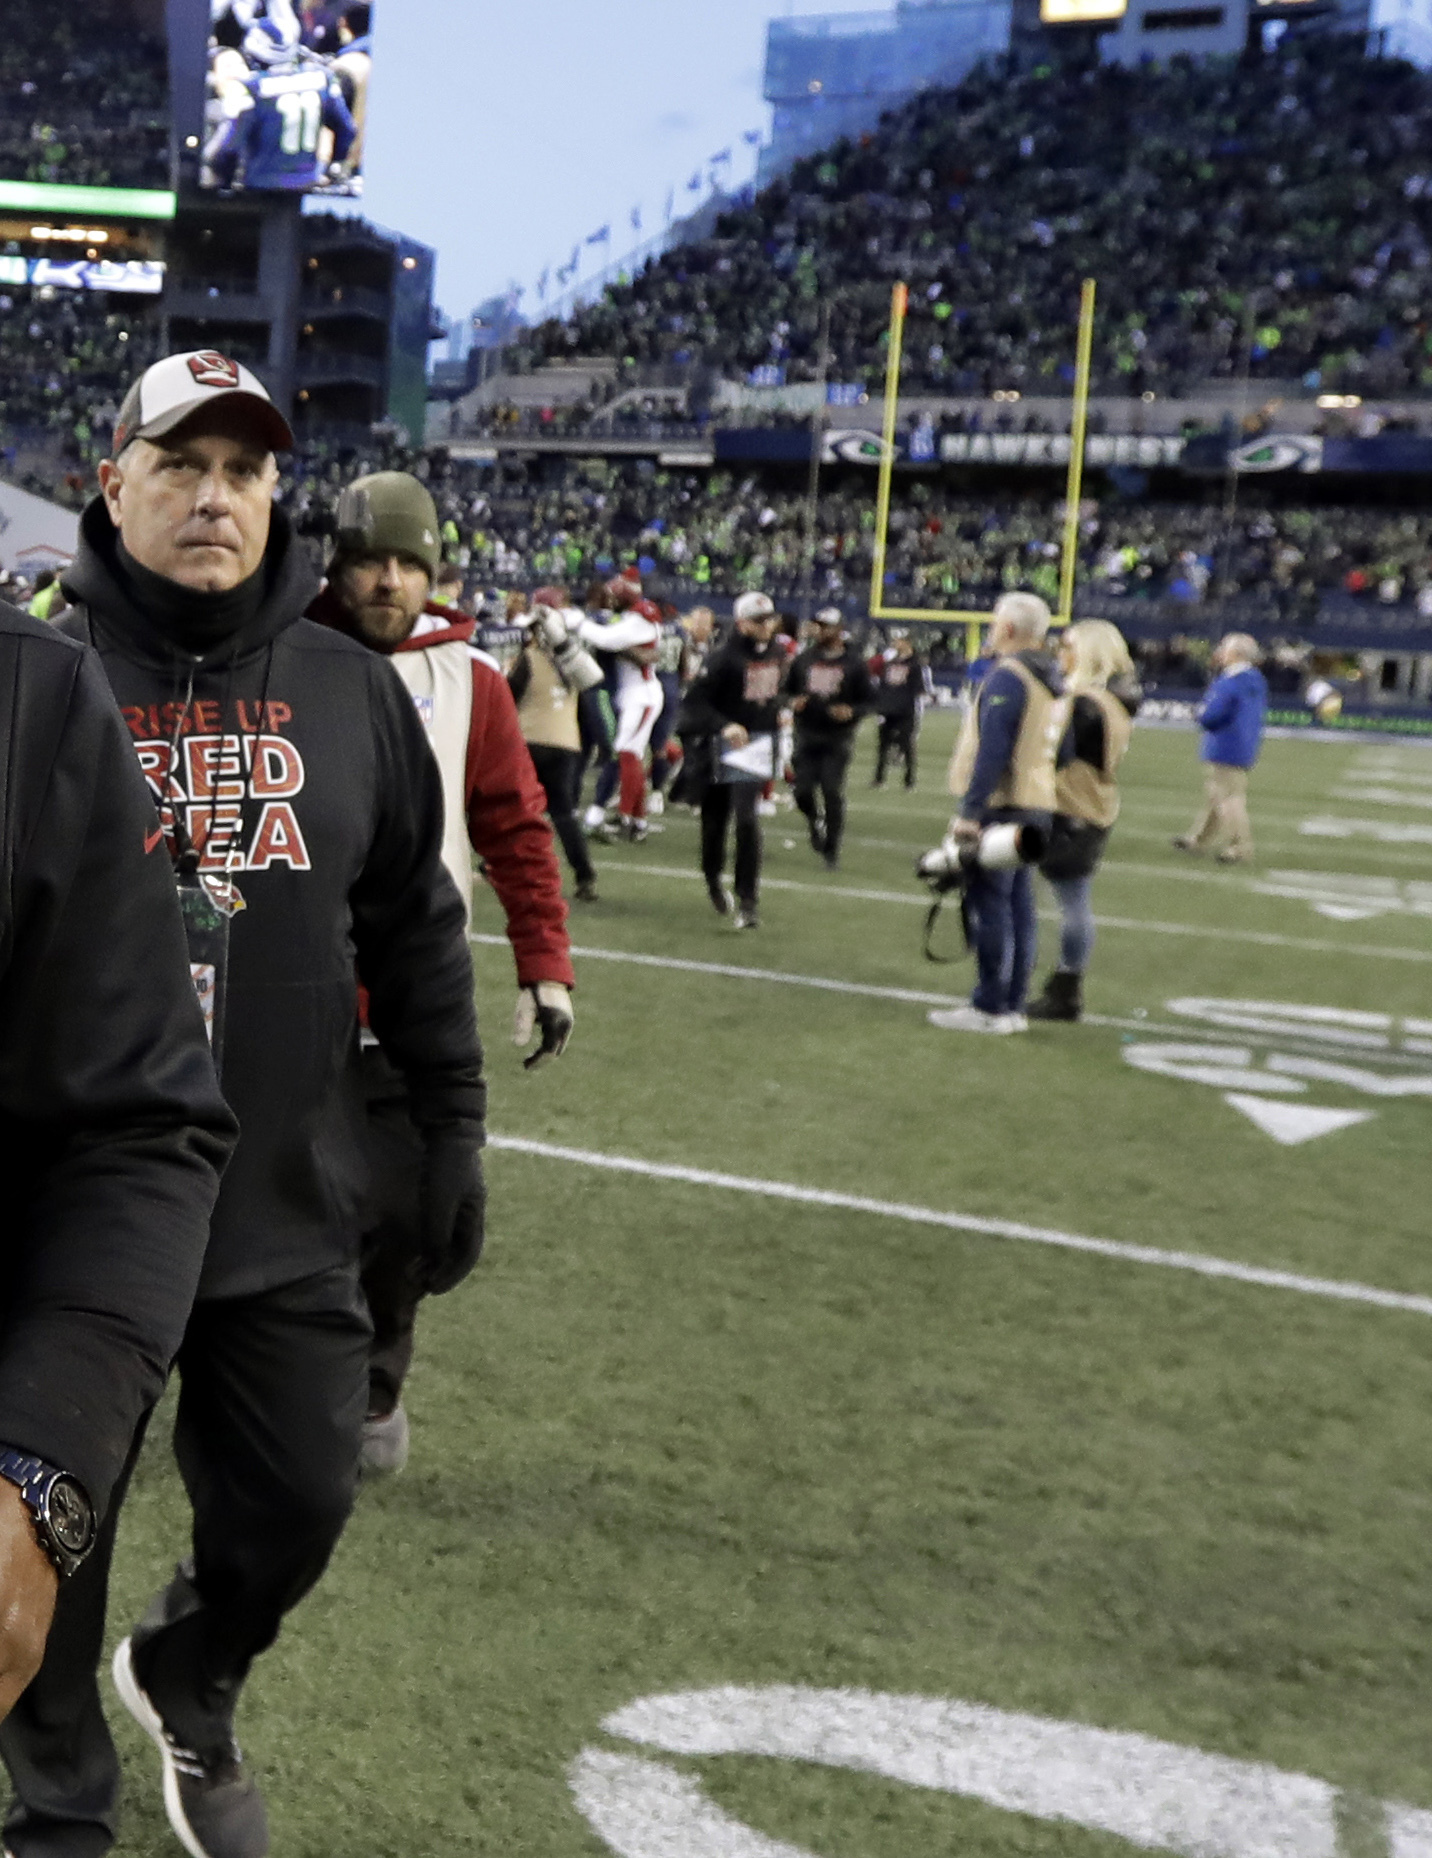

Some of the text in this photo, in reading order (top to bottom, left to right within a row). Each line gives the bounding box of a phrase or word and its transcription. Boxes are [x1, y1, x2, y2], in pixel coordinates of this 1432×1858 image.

[121, 698, 293, 738] RISE UP
[133, 734, 305, 804] RED
